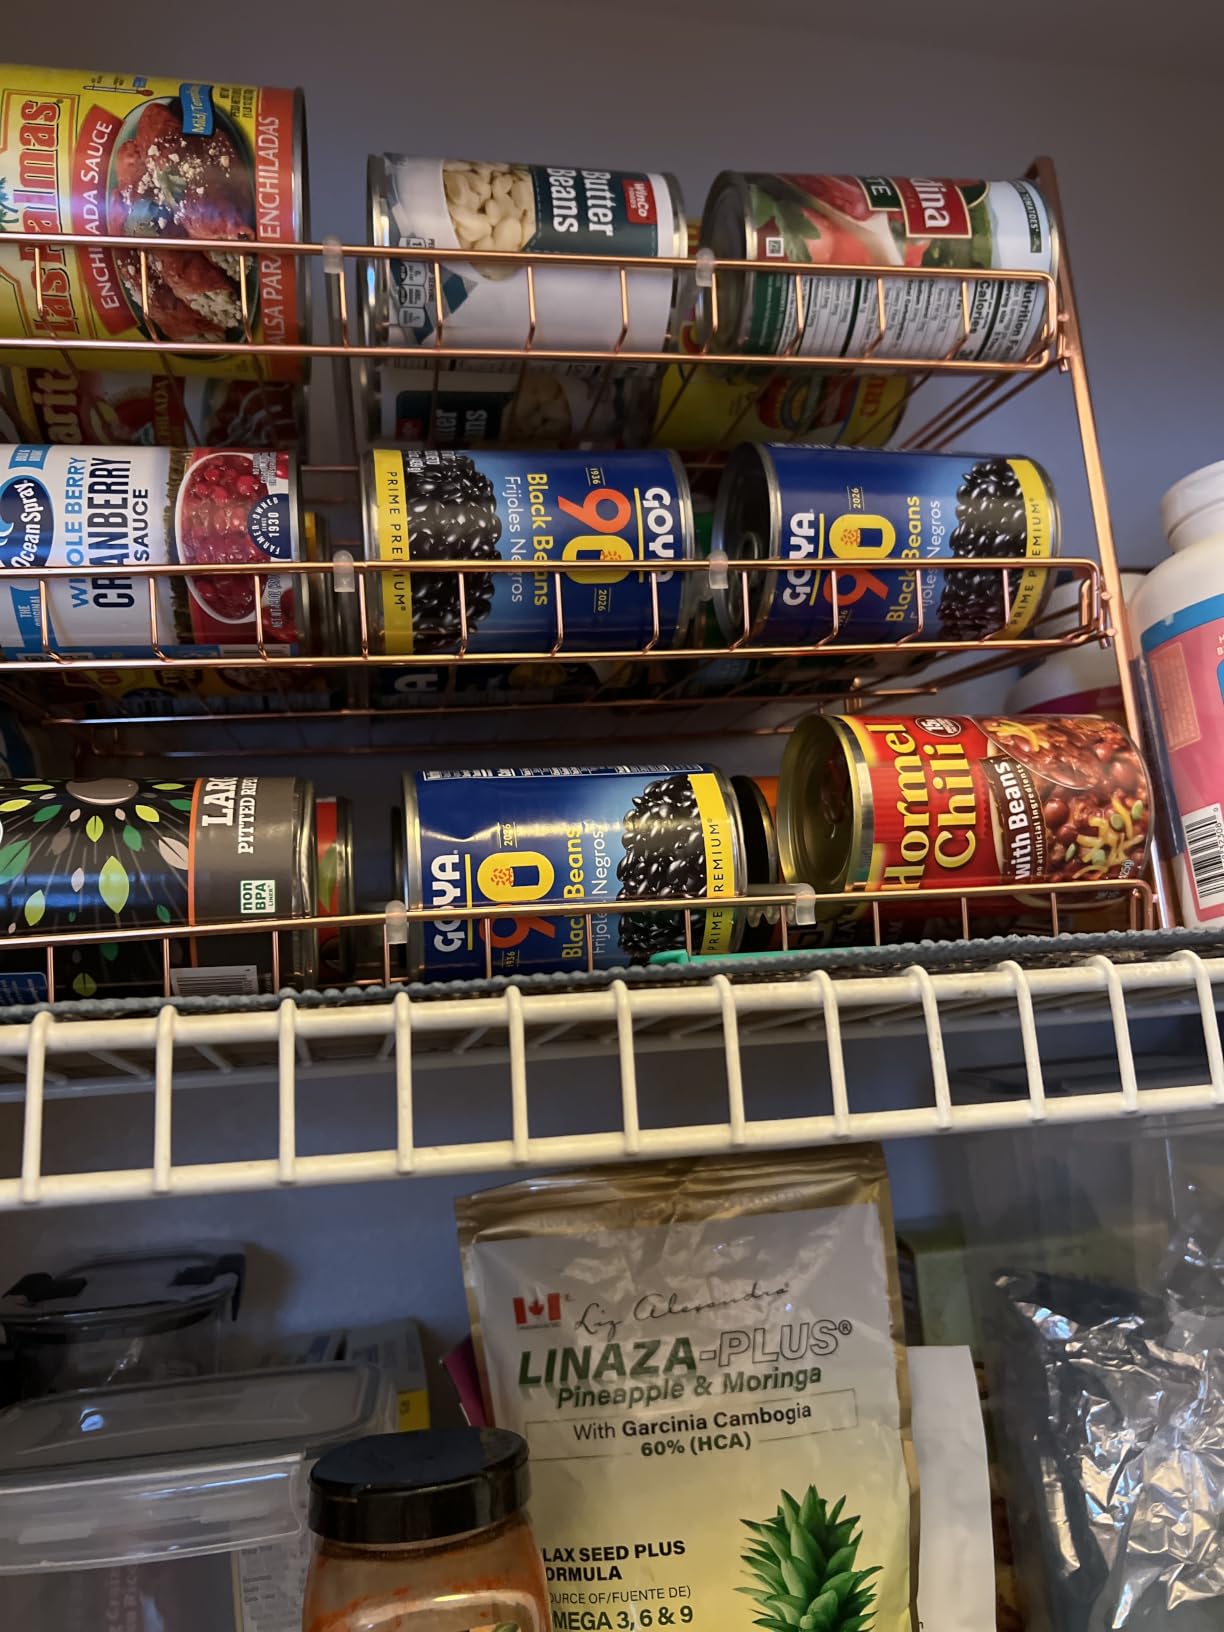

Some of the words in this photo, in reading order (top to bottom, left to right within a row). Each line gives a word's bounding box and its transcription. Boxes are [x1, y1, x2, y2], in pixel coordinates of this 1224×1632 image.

[81, 120, 113, 184] SAUCE
[257, 116, 280, 239] ENCHILADAS
[547, 168, 579, 233] Beans
[633, 183, 649, 217] WinCo
[581, 170, 615, 236] Butter
[82, 190, 120, 309] ENCHIADA
[263, 306, 286, 345] ALSA
[969, 280, 990, 334] Calories
[1011, 281, 1035, 337] Nutrition
[14, 481, 43, 522] Spray
[64, 457, 86, 514] BERRY
[386, 471, 401, 516] PRIME
[502, 476, 525, 533] Frijoles
[526, 473, 553, 530] Black
[852, 487, 862, 509] 2026
[11, 525, 41, 567] Ocean
[132, 488, 149, 561] SAUCE
[268, 512, 280, 538] 1930
[589, 467, 601, 486] 1936
[597, 589, 607, 612] 2026
[1027, 500, 1042, 578] PEMIUM
[391, 524, 405, 606] PREIUM
[18, 605, 32, 618] THE
[201, 777, 239, 827] LAR
[865, 724, 929, 890] Hormel
[923, 743, 977, 869] Chili
[994, 760, 1029, 830] Beans
[1016, 763, 1039, 819] ingredients
[238, 797, 256, 854] PITTED
[503, 823, 513, 847] 2026
[1032, 821, 1044, 864] artificial
[563, 826, 585, 899] Beans
[592, 828, 611, 895] Negros
[711, 822, 724, 893] REMIUM
[1010, 832, 1032, 879] with
[242, 882, 253, 911] non
[255, 883, 266, 910] BPA
[562, 912, 584, 959] Blac
[707, 909, 723, 951] PRIME
[557, 1376, 685, 1409] Pineapple
[694, 1375, 713, 1397] &
[723, 1364, 822, 1395] Moringa
[573, 1422, 617, 1441] With
[621, 1415, 708, 1438] Garcinia
[713, 1403, 812, 1429] Cambogia
[640, 1439, 685, 1458] 60%
[690, 1432, 752, 1455] (HCA)
[543, 1547, 576, 1563] LAX
[579, 1544, 630, 1563] SEED
[634, 1540, 686, 1560] PLUS
[545, 1566, 623, 1583] ORMULA
[553, 1612, 611, 1631] MEGA
[617, 1611, 635, 1632] 3,
[640, 1609, 653, 1627] 6
[657, 1606, 675, 1626] &
[679, 1605, 694, 1624] 9
[588, 1587, 666, 1605] OF/FUENTE
[669, 1586, 692, 1600] DE)
